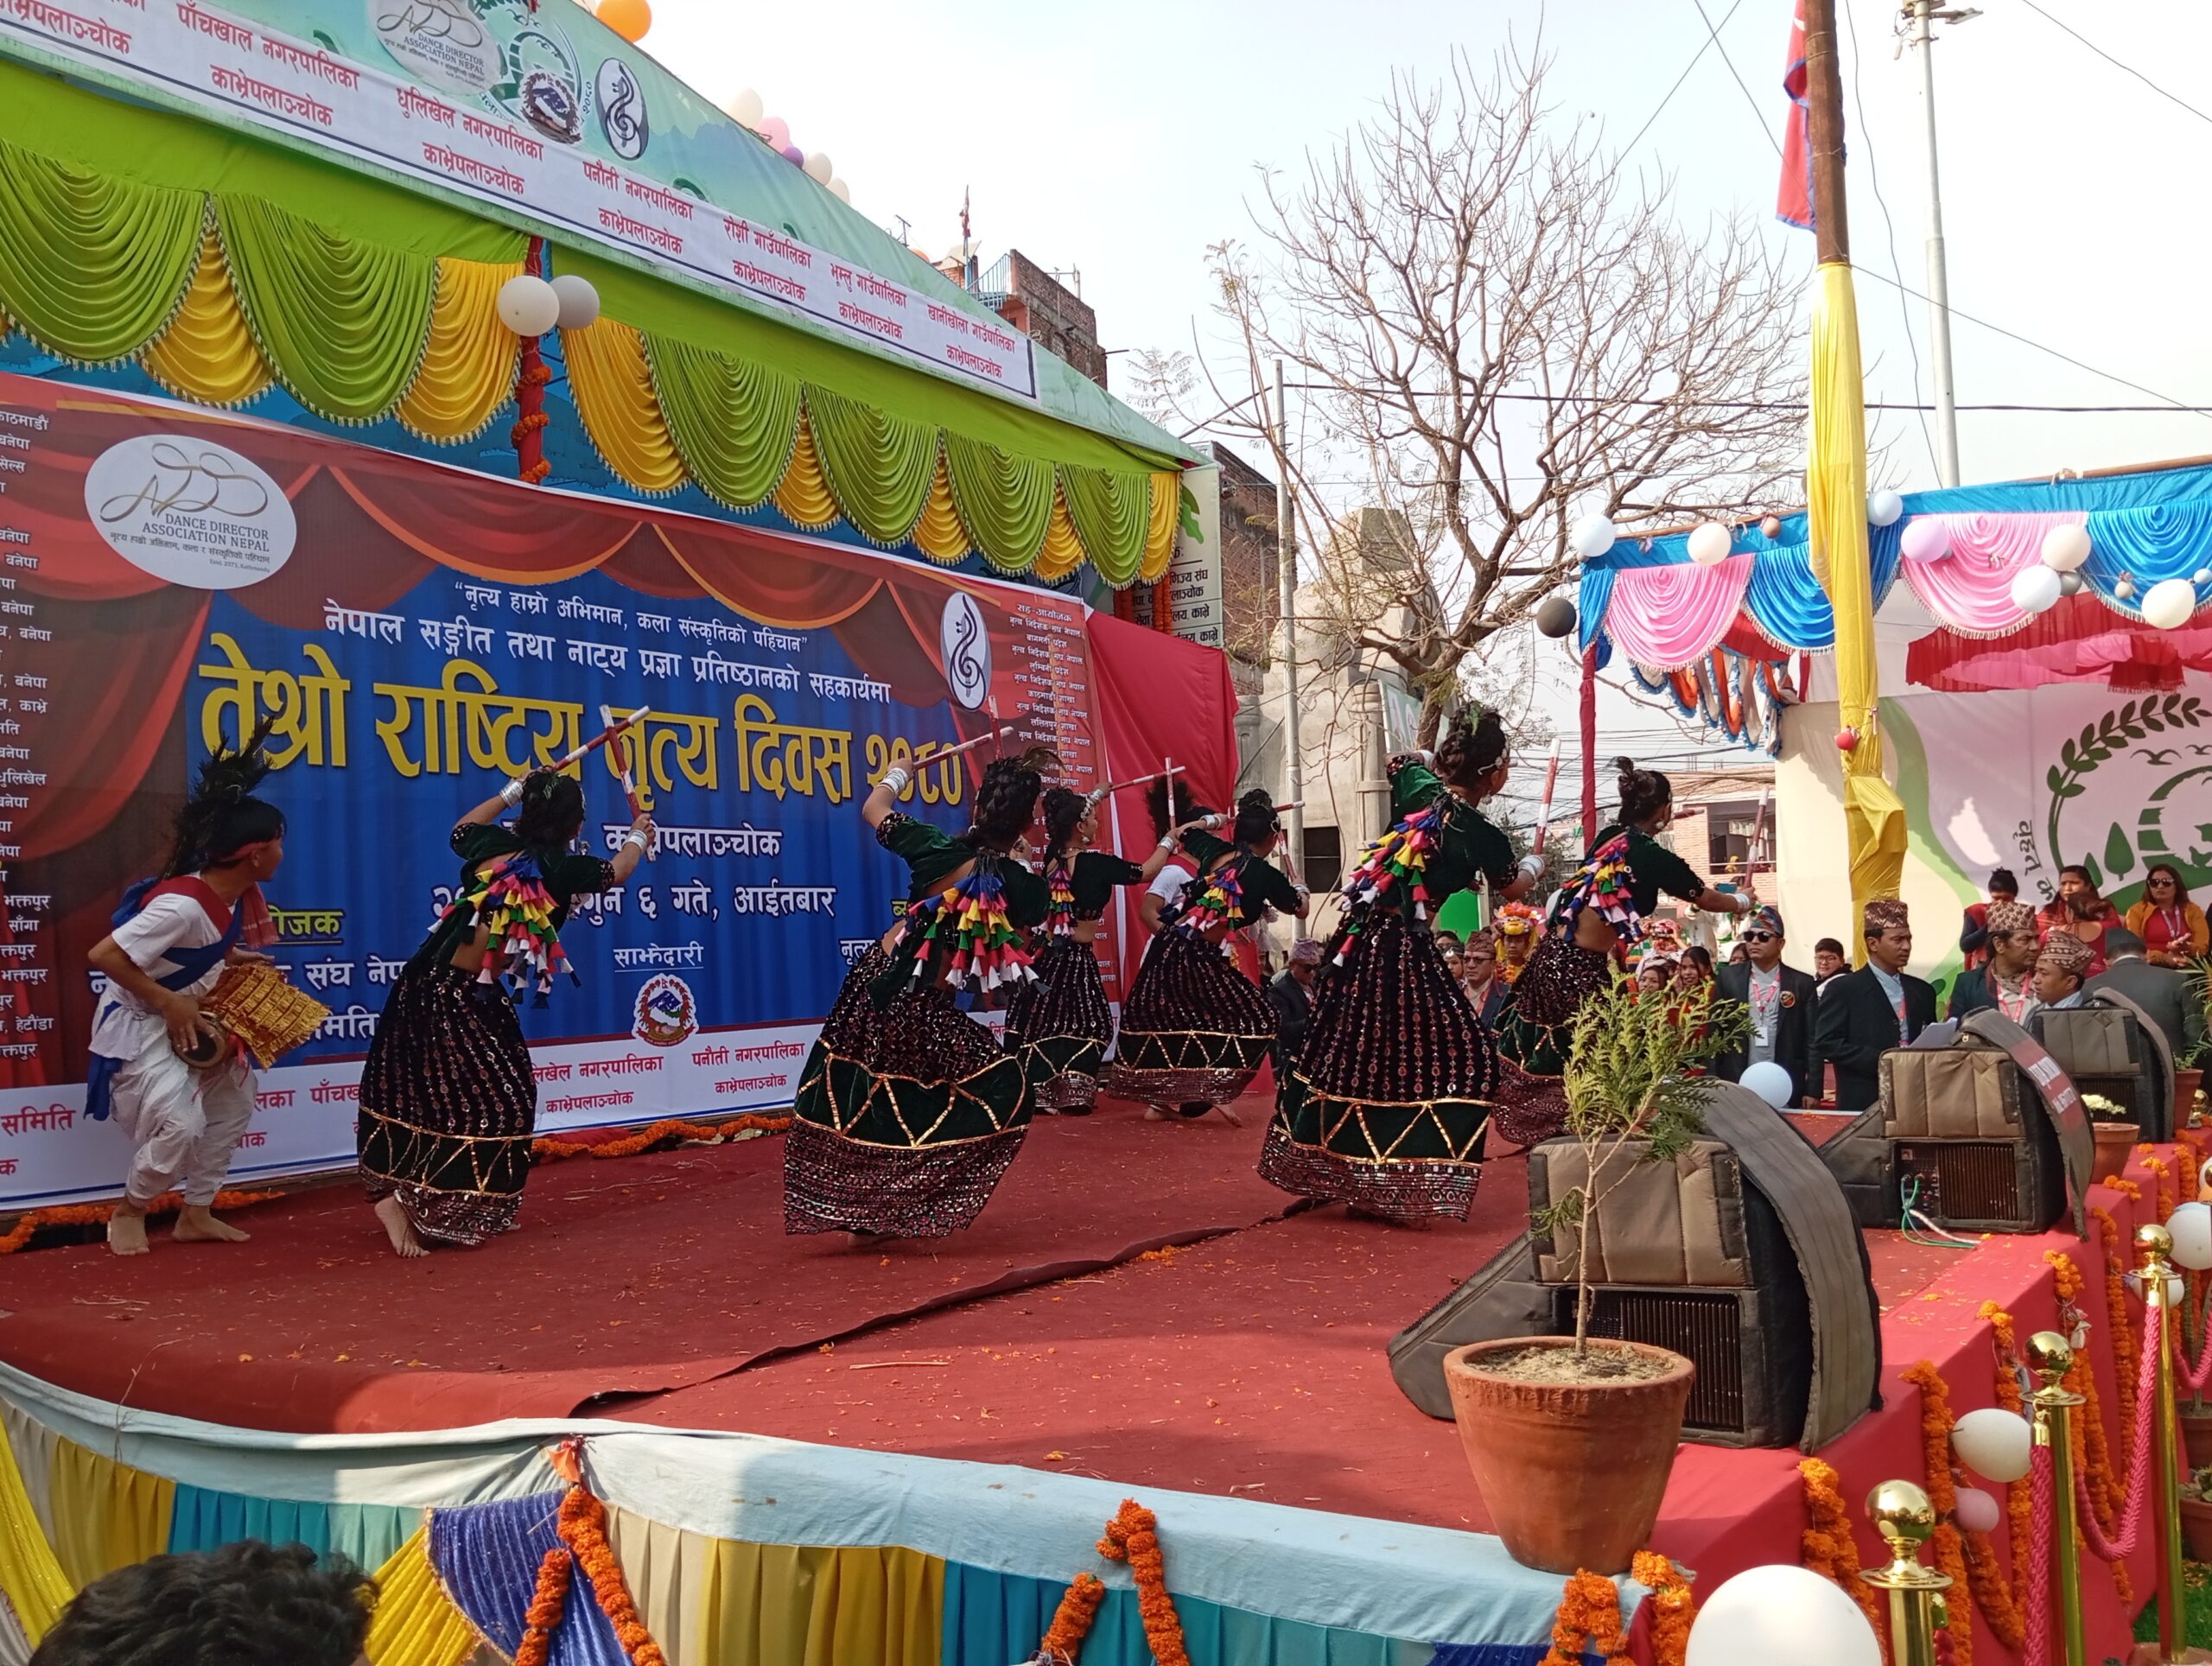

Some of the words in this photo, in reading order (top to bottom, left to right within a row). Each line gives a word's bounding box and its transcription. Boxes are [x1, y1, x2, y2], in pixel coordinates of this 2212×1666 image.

[261, 35, 360, 91] नगरपालिका
[404, 36, 456, 64] ASSOCIATION
[459, 59, 484, 75] NEPAL
[418, 34, 443, 51] DANCE
[445, 48, 484, 67] DIRECTOR
[210, 64, 334, 126] काभ्रेपलाञ्चोक
[396, 86, 456, 129] धुलिखेल
[462, 113, 543, 162] नगरपालिका
[423, 142, 524, 194] काभ्रेपलाञ्चोक
[582, 159, 619, 192] पनौती
[624, 178, 693, 220] नगरपालिका
[598, 207, 683, 254] काभ्रेपलाञ्चोक
[723, 216, 749, 244] रोशी
[753, 229, 811, 269] गाउँपालिका
[733, 259, 806, 302] काभ्रेपलाञ्चोक
[856, 272, 906, 308] गाउँपालिका
[838, 302, 903, 340] काभ्रेपलाञ्चोक
[946, 345, 1002, 378] काभ्रेपलाञ्चोक
[143, 523, 226, 545] ASSOCIATION
[231, 536, 269, 552] NEPAL
[165, 513, 207, 531] DANCE
[210, 521, 269, 540] DIRECTOR
[5, 553, 39, 569] बनेपा
[1194, 568, 1208, 582] संघ
[1, 600, 35, 615] बनेपा
[509, 591, 548, 614] हाम्रो
[557, 596, 627, 631] अभिमान,
[637, 612, 671, 633] कला
[678, 617, 747, 645] संस्कृतिको
[19, 626, 52, 641] बनेपा
[323, 598, 405, 645] नेपाल
[418, 615, 495, 657] सङ्गीत
[505, 630, 556, 662] तथा
[566, 639, 628, 677] नाट्य
[639, 649, 682, 679] प्रज्ञा
[691, 650, 800, 692] प्रतिष्ठानको
[809, 672, 891, 703] सहकार्यमा
[15, 673, 48, 689] बनेपा
[19, 698, 48, 714] काभ्रे
[734, 693, 852, 804] दिवस
[4, 895, 51, 911] भक्तपुर
[639, 887, 658, 919] ६
[672, 880, 718, 921] गते,
[734, 877, 836, 918] आईतबार
[9, 914, 40, 932] साँगा
[613, 940, 704, 968] साझेदारी
[1, 969, 48, 985] भक्तपुर
[305, 957, 354, 990] संघ
[579, 1053, 664, 1079] नगरपालिका
[691, 1046, 728, 1067] पनौती
[735, 1040, 804, 1064] नगरपालिका
[715, 1072, 787, 1094] काभ्रेपलाञ्चोक
[545, 1090, 633, 1113] काभ्रेपलाञ्चोक
[1, 1103, 76, 1135] समिति
